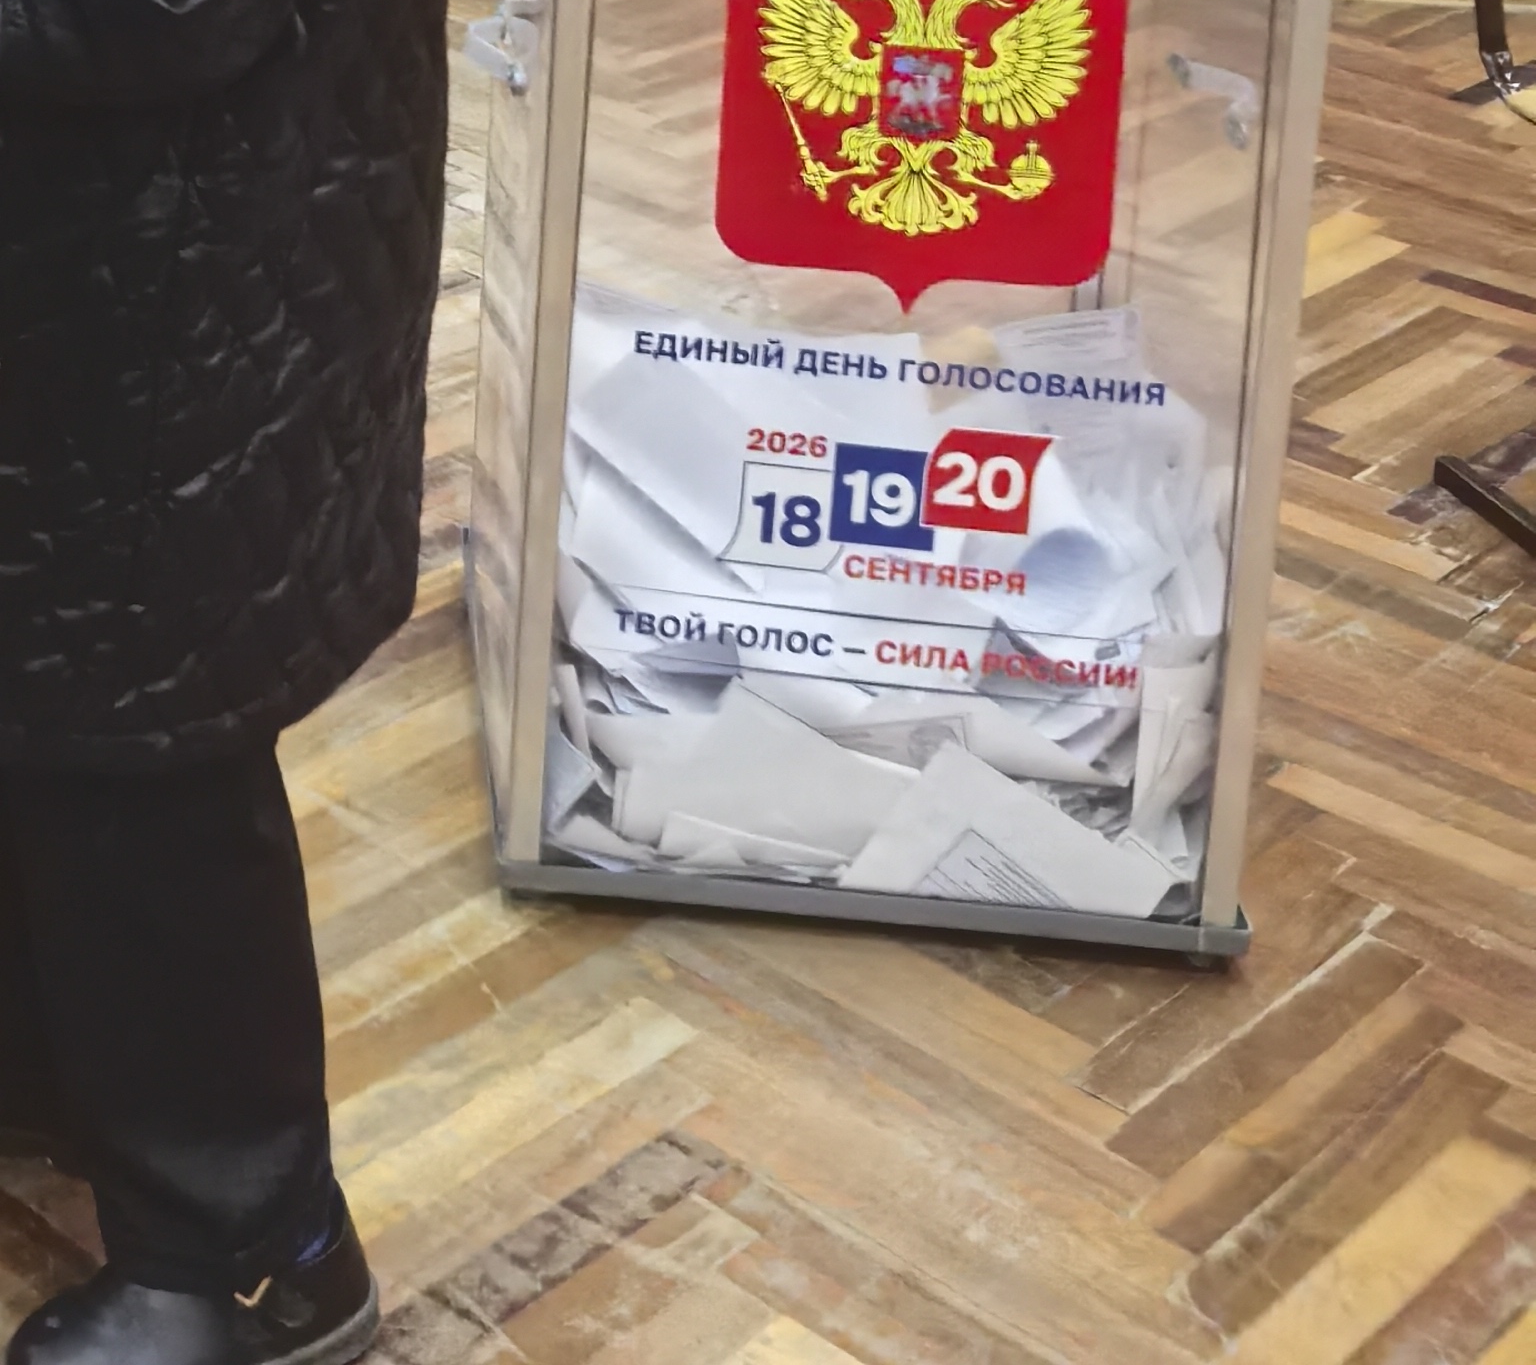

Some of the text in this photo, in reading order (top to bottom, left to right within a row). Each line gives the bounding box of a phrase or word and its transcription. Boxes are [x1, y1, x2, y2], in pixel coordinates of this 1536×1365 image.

[634, 330, 1165, 406] ЕДИНЫЙ ДЕНЬ ГОЛОСОВАНИЯ
[746, 428, 828, 458] 2026
[752, 451, 1027, 547] 18 19 20
[843, 554, 1027, 596] СЕНТЯБРЯ
[615, 609, 707, 642] ТВОЙ
[717, 621, 834, 657] ГОЛОС
[875, 640, 971, 674] СИЛА
[982, 652, 1140, 690] РОССИИ!
